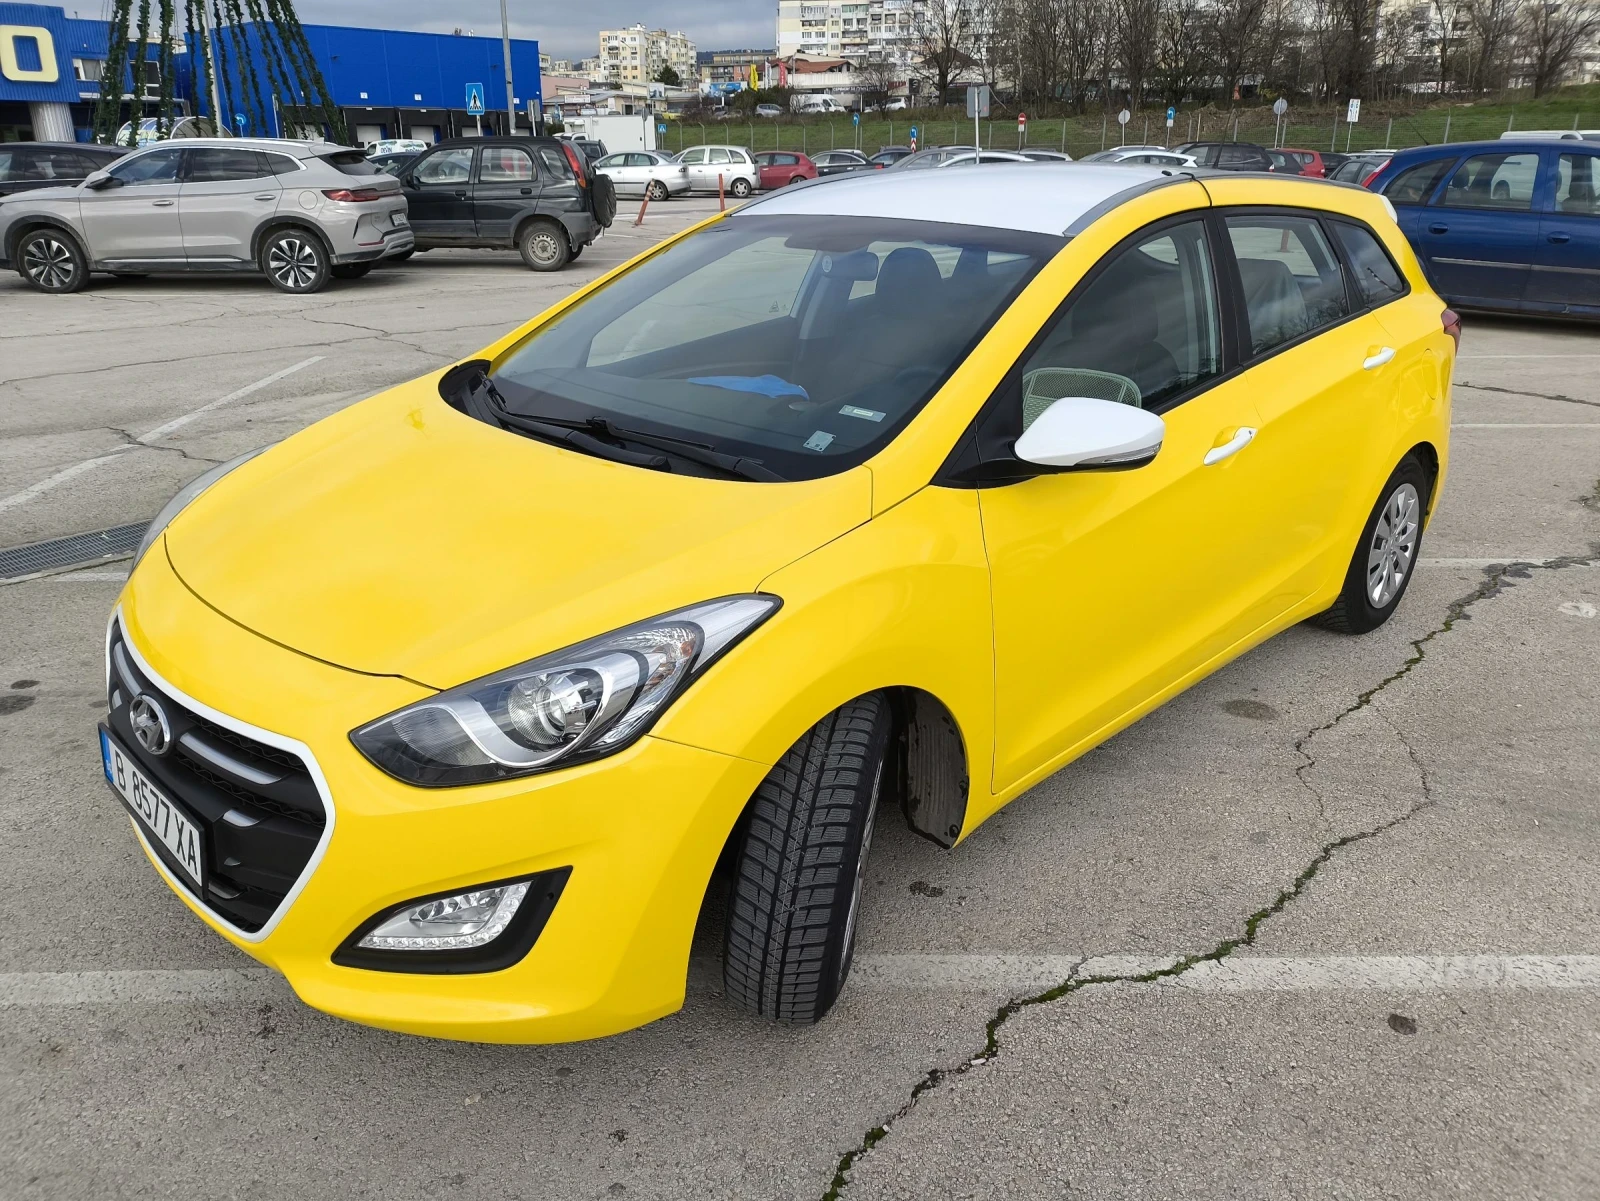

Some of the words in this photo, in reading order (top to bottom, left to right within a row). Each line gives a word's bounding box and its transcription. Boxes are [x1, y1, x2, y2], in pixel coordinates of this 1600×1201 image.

[115, 749, 126, 792] B
[132, 771, 171, 839] 8577
[174, 812, 198, 876] XA
